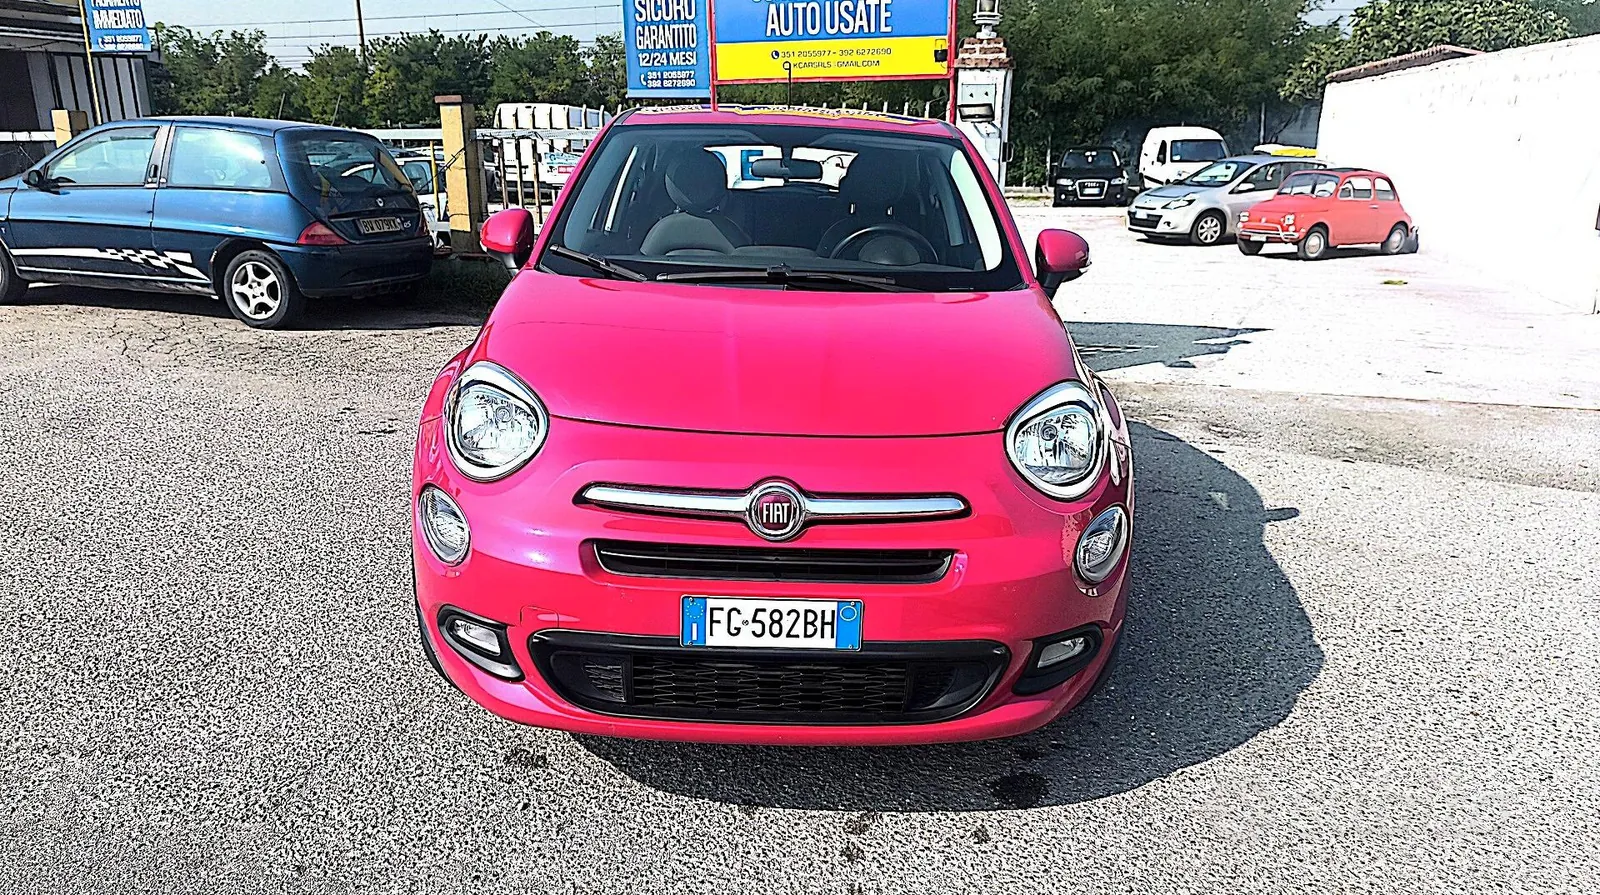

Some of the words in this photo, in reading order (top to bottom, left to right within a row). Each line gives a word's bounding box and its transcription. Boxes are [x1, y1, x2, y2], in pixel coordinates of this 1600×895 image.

[766, 2, 821, 37] AUTO
[825, 0, 892, 35] USATE
[636, 23, 698, 50] GARANTITO
[638, 52, 668, 67] 12/24
[669, 51, 697, 66] MESI
[781, 50, 796, 59] 351
[762, 502, 790, 524] FIAT
[709, 606, 742, 637] FG
[751, 607, 836, 639] 582BH
